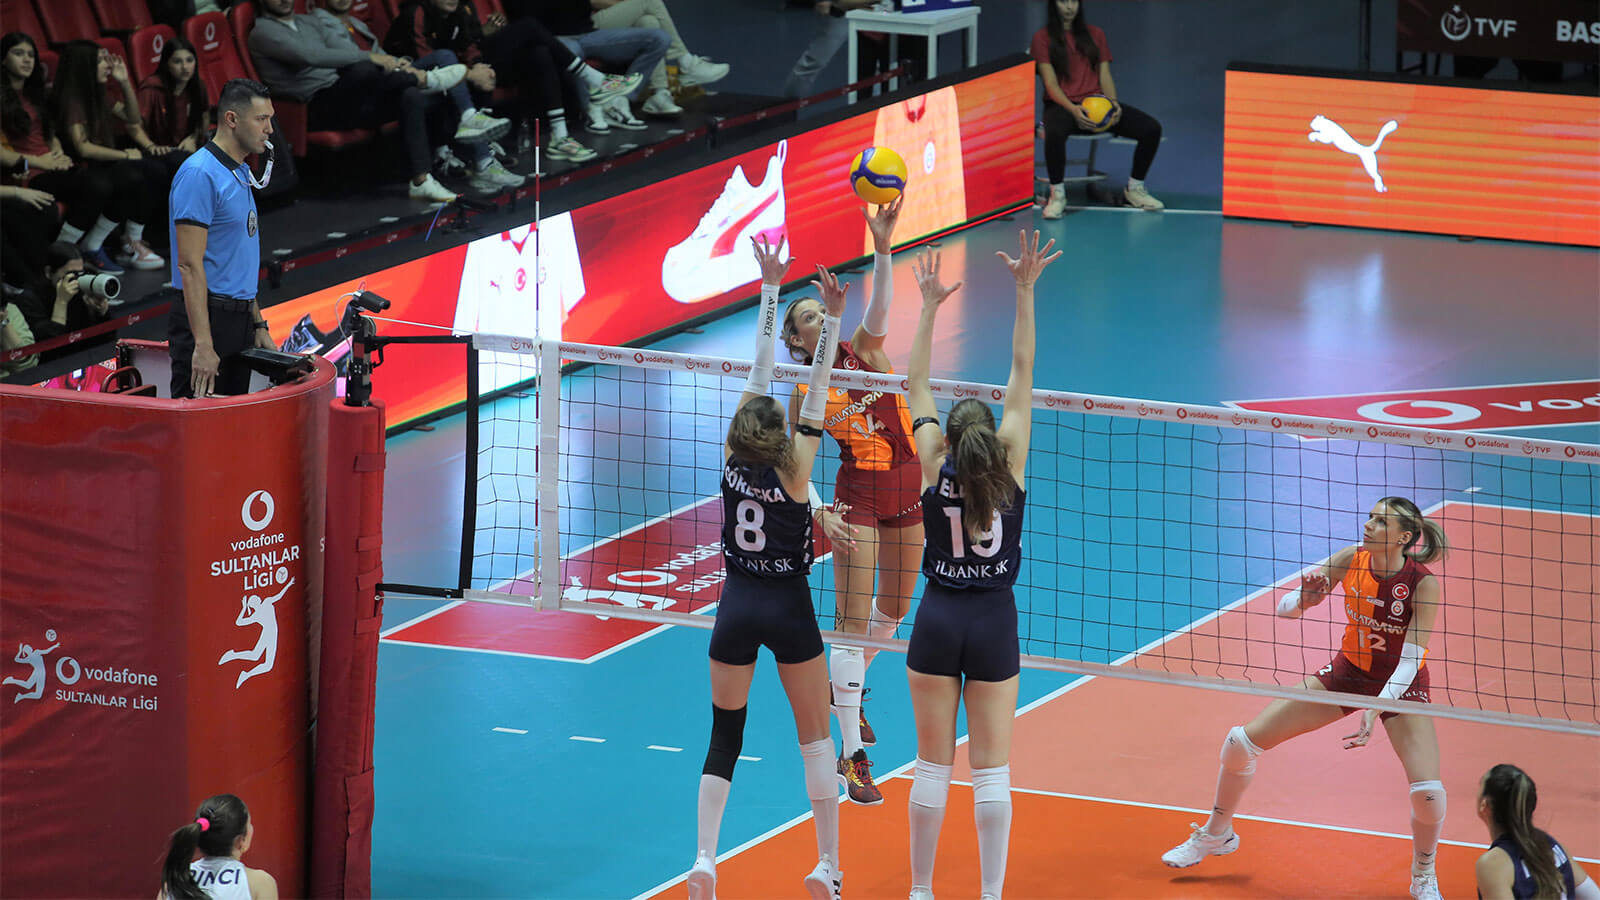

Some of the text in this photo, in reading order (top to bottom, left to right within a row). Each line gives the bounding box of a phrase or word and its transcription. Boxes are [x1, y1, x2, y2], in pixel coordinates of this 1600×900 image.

[1474, 17, 1517, 38] TVF
[763, 305, 776, 338] TERREX
[815, 336, 827, 366] TERREX
[608, 352, 622, 360] TVF
[645, 355, 674, 365] vodafone
[696, 362, 711, 370] TVF
[784, 370, 799, 378] TVF
[875, 379, 889, 387] TVF
[965, 388, 979, 396] TVF
[1056, 398, 1071, 407] TVF
[1095, 401, 1125, 411] vodafone
[1149, 406, 1163, 415] TVF
[1188, 411, 1219, 420] vodafone
[1244, 416, 1258, 425] TVF
[1283, 421, 1314, 430] vodafone
[1338, 426, 1354, 435] TVF
[1379, 431, 1411, 439] vodafone
[1436, 436, 1452, 444] TVF
[1477, 440, 1509, 449] vodafone
[1535, 445, 1551, 454] TVF
[851, 413, 886, 439] 14
[735, 499, 767, 552] 8
[942, 506, 1003, 558] 19
[230, 532, 285, 552] vodafone
[210, 545, 300, 577] SULTANLAR
[774, 558, 794, 573] SK
[994, 559, 1009, 575] SK
[243, 567, 273, 591] LİGİ
[1358, 628, 1387, 652] 12
[84, 666, 158, 687] vodafone
[55, 689, 158, 711] SULTANLAR LİGİ
